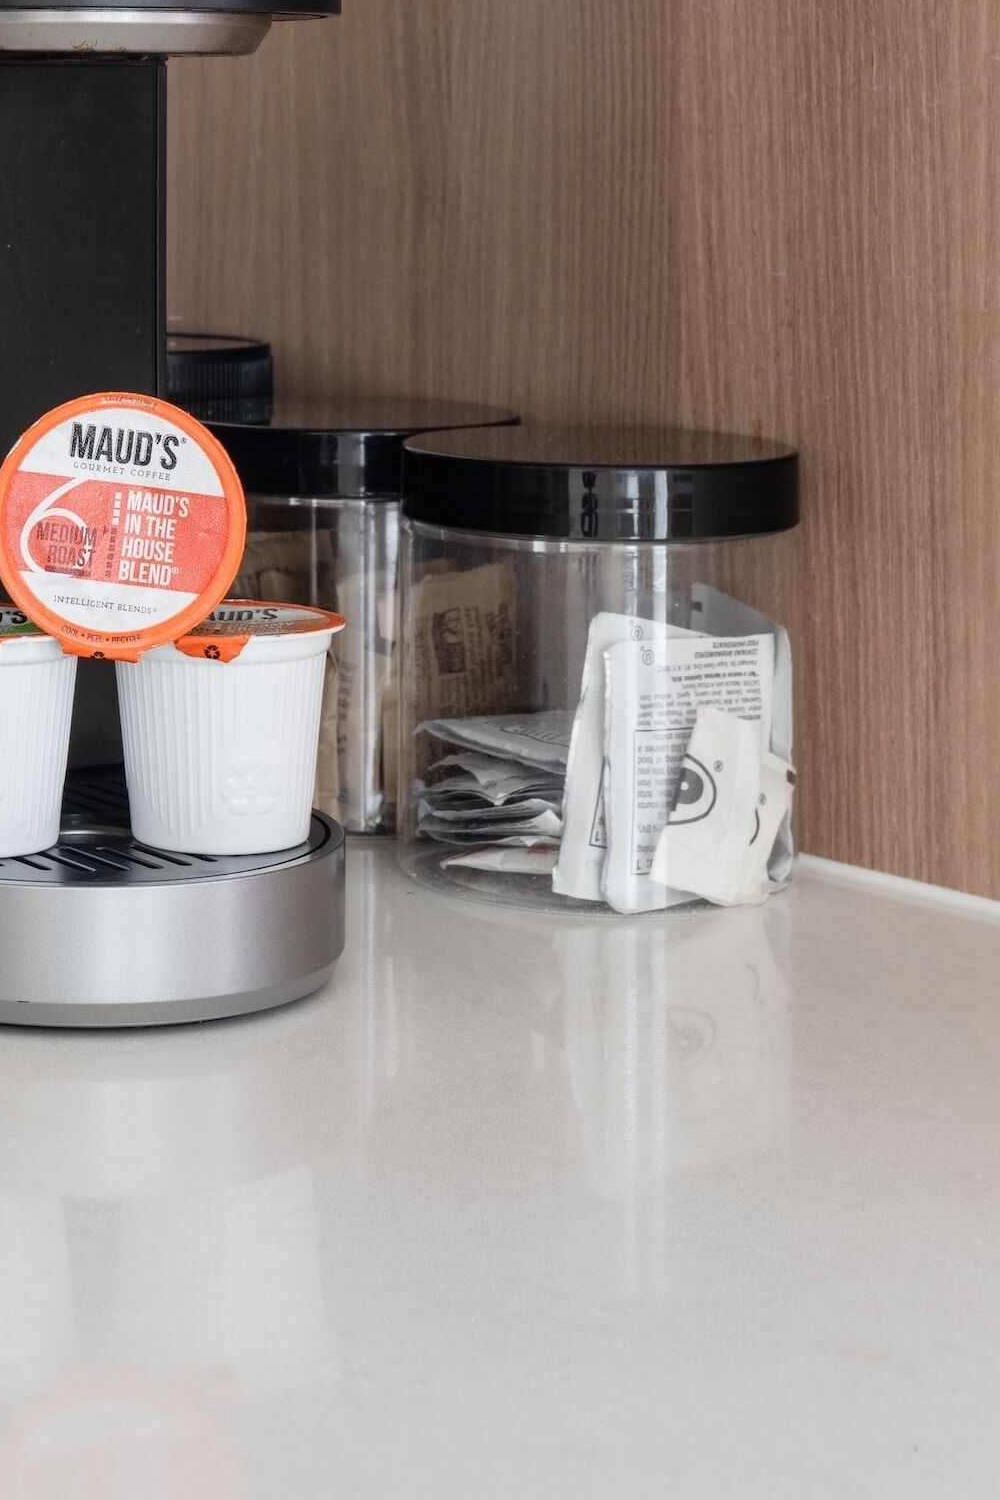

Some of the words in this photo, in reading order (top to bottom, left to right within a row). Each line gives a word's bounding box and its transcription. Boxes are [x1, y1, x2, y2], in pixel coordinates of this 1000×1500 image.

[73, 461, 126, 476] GOURMET
[130, 468, 172, 481] COFFEE
[126, 489, 190, 518] MAUD'S
[35, 521, 97, 548] MEDIUM
[124, 512, 142, 536] IN
[145, 515, 177, 540] THE
[46, 544, 96, 568] ROAST
[121, 536, 176, 563] HOUSE
[53, 595, 115, 610] INTELLIGENT
[205, 608, 279, 621] AUD'S
[61, 624, 80, 638] COOL
